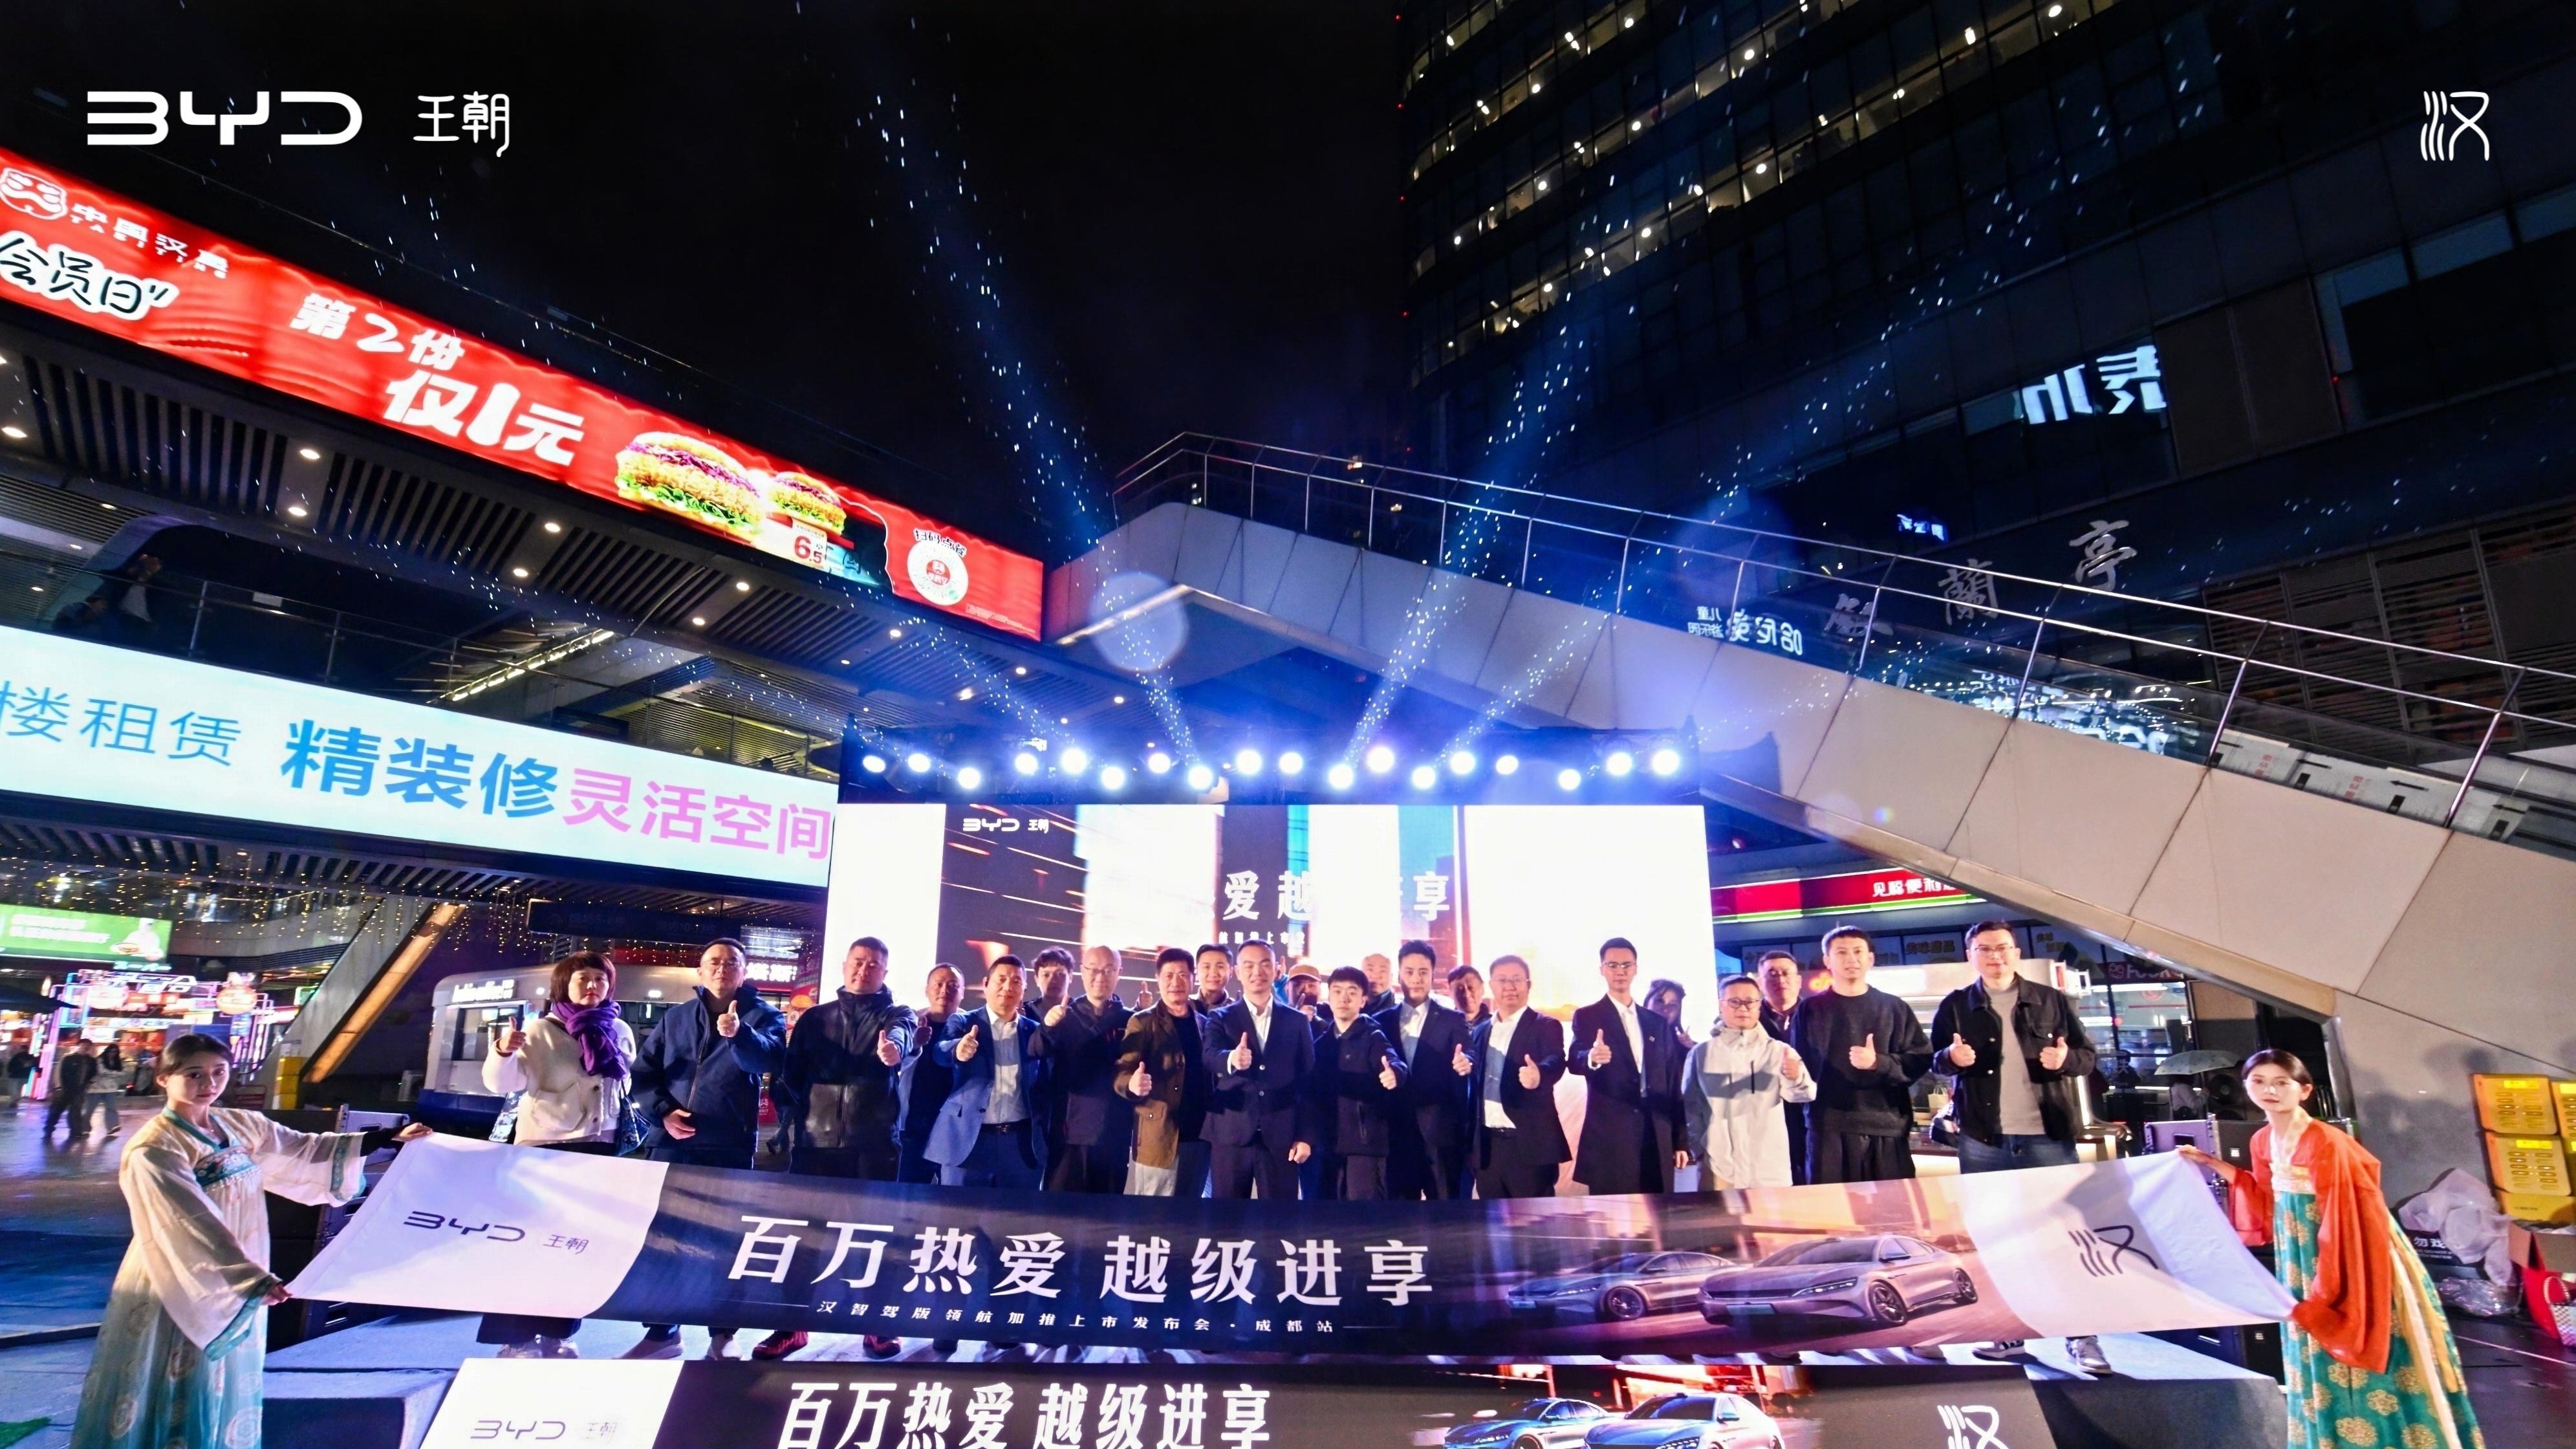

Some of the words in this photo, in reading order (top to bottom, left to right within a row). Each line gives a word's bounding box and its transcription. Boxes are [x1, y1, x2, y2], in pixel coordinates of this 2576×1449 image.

[289, 293, 465, 370] 第2份
[384, 369, 585, 466] 仅1元
[794, 536, 822, 564] 6.5
[963, 818, 1020, 832] BYD
[403, 1210, 526, 1243] BYD
[543, 1233, 589, 1255] 王朝
[727, 1215, 1065, 1299] 百万热爱
[1099, 1236, 1434, 1307] 越级进享
[2068, 1225, 2159, 1277] 汉
[470, 1420, 566, 1441] BYD
[776, 1382, 1012, 1449] 百万热爱
[1033, 1382, 1270, 1449] 越级进享
